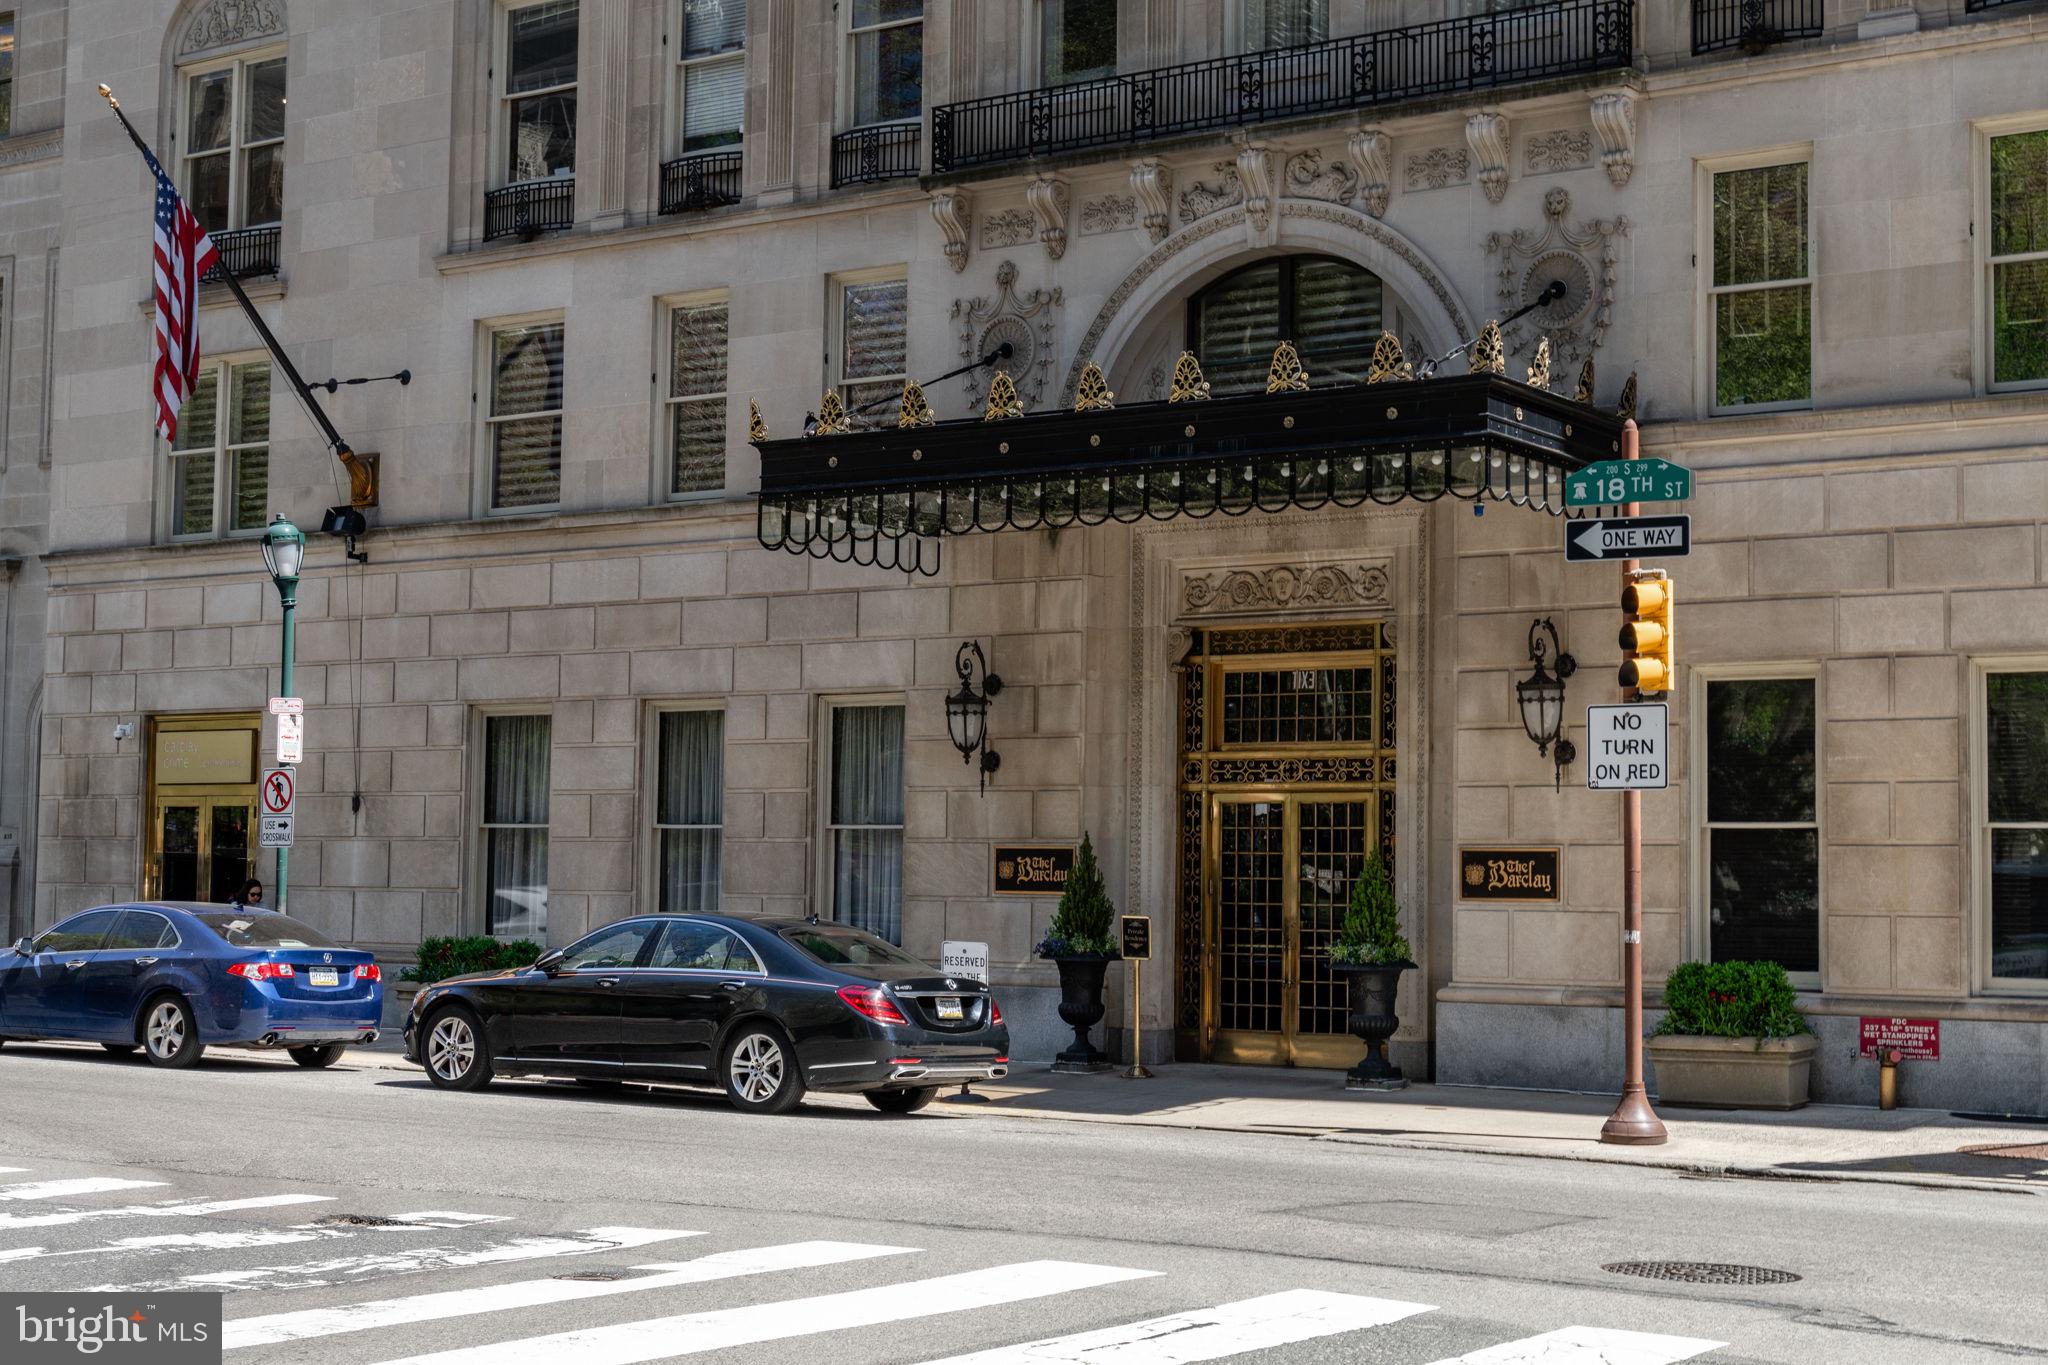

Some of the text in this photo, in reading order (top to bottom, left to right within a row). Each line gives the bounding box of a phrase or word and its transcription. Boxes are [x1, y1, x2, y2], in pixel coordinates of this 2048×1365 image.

[1606, 463, 1648, 475] 200 S 299
[1665, 481, 1683, 498] ST
[1602, 529, 1675, 547] ONE WAY
[1613, 714, 1641, 730] NO
[1602, 739, 1654, 755] TURN
[1596, 764, 1660, 780] ON RED
[264, 821, 276, 830] USE
[263, 833, 291, 842] CROSSWALK
[1506, 860, 1529, 873] The
[1488, 860, 1551, 892] Barclay
[944, 956, 985, 967] RESERVED
[1882, 1032, 1928, 1040] STANDPIPES
[1877, 1039, 1923, 1047] SPRINKLERS
